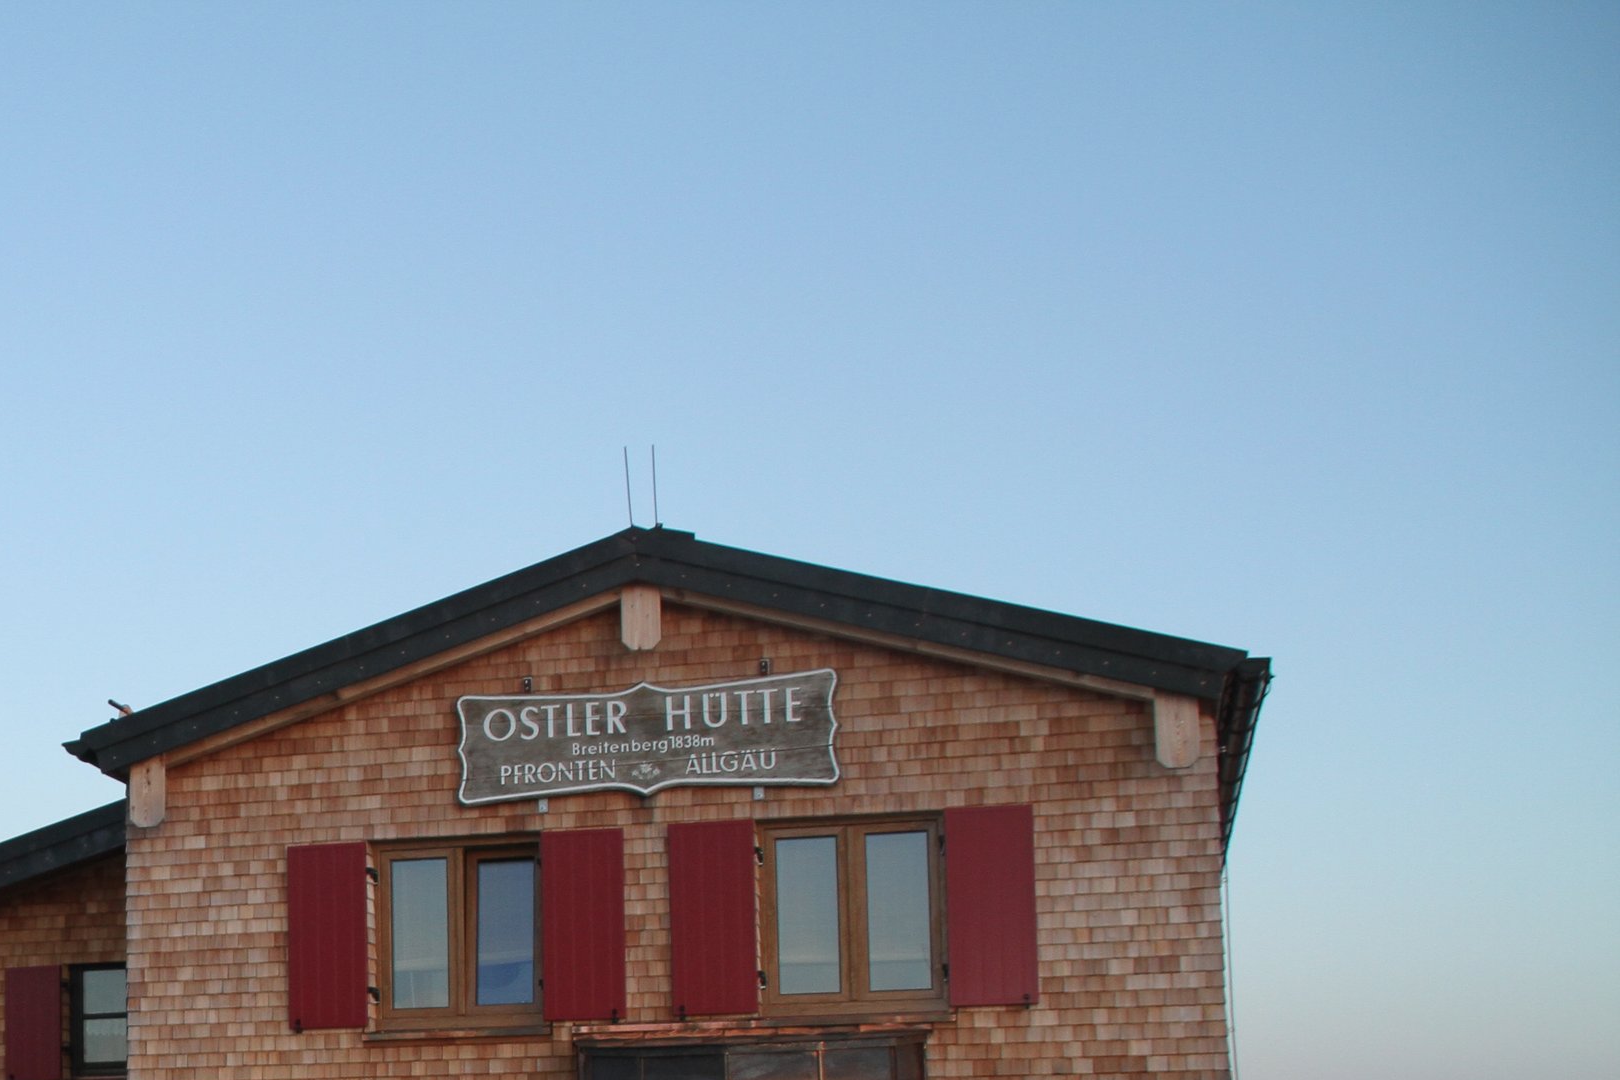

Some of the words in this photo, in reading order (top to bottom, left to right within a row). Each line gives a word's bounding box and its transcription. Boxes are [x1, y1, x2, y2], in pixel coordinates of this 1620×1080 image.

[483, 700, 628, 742] OSTLER
[665, 686, 802, 731] HÜTTE
[571, 739, 668, 756] Breitenberg
[500, 759, 616, 785] PFRONTEN
[685, 748, 777, 775] ALLGÄU
